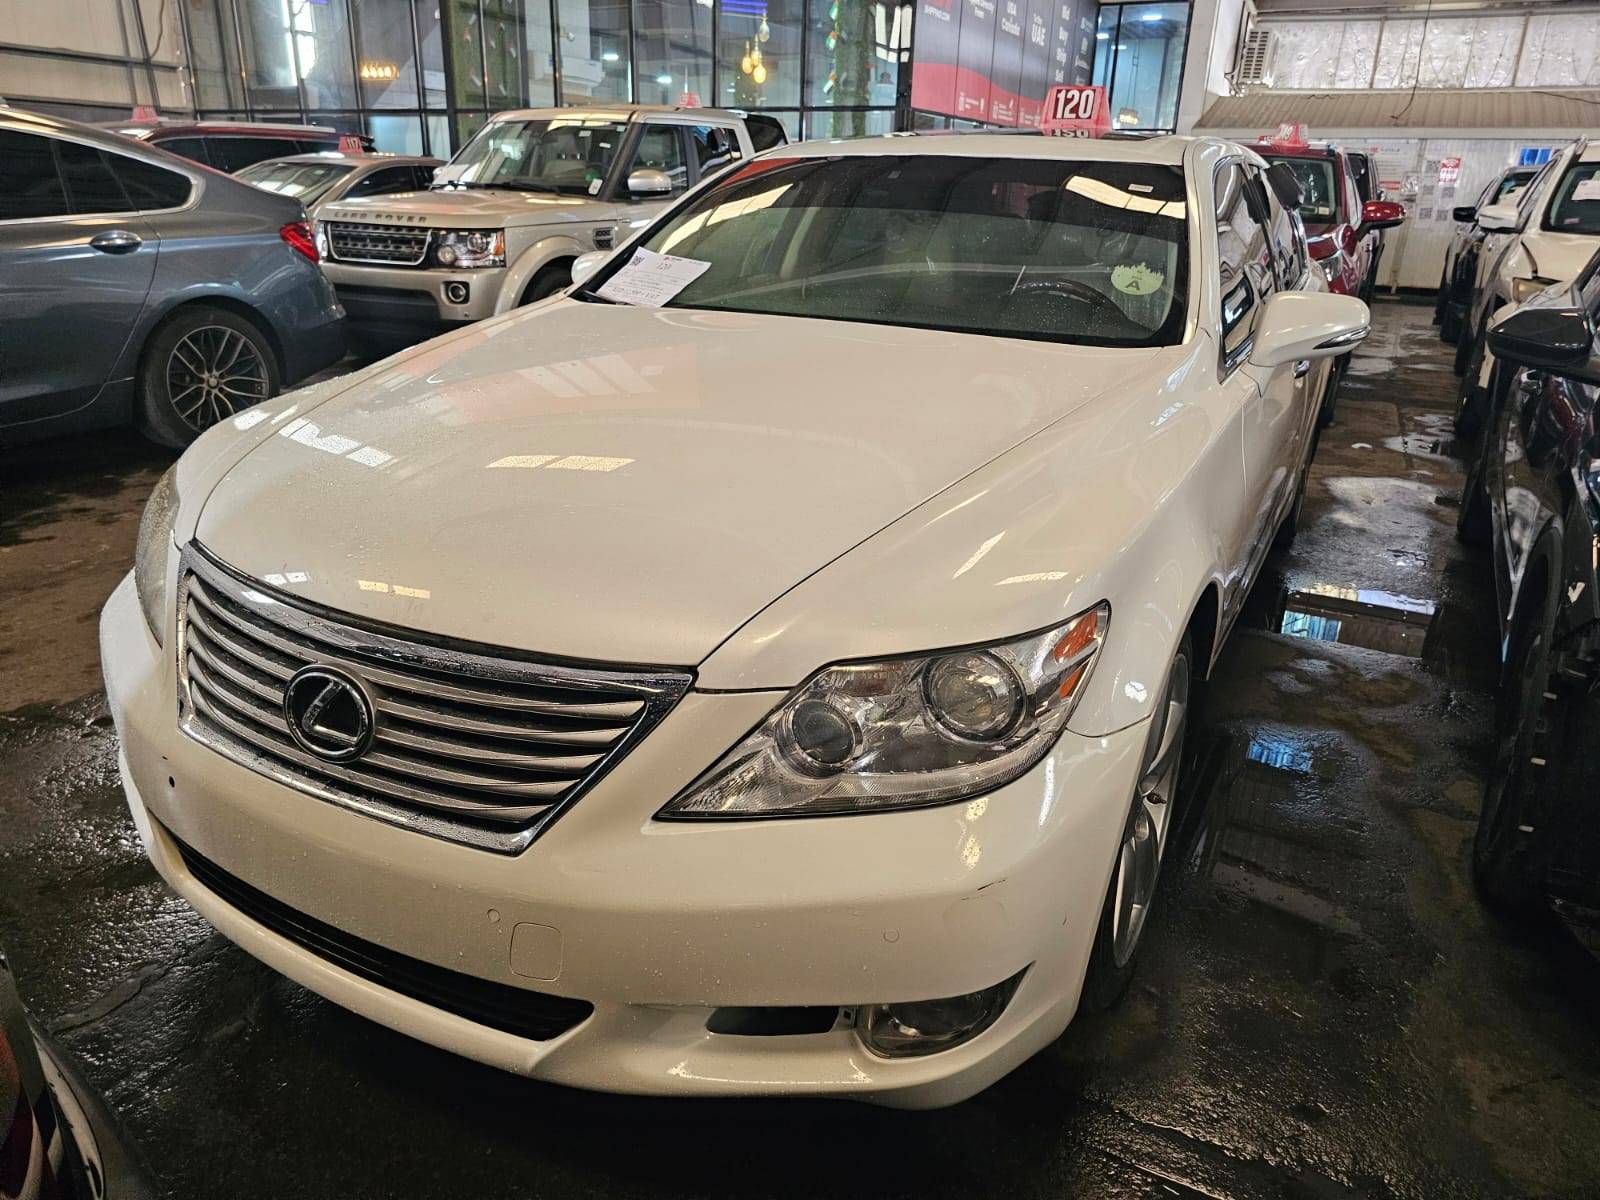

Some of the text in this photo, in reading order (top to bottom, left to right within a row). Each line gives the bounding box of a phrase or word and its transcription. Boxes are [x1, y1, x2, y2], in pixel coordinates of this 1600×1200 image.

[1031, 24, 1046, 47] UAE
[1055, 88, 1095, 119] 120
[375, 213, 427, 224] ROVER
[1124, 279, 1141, 291] A
